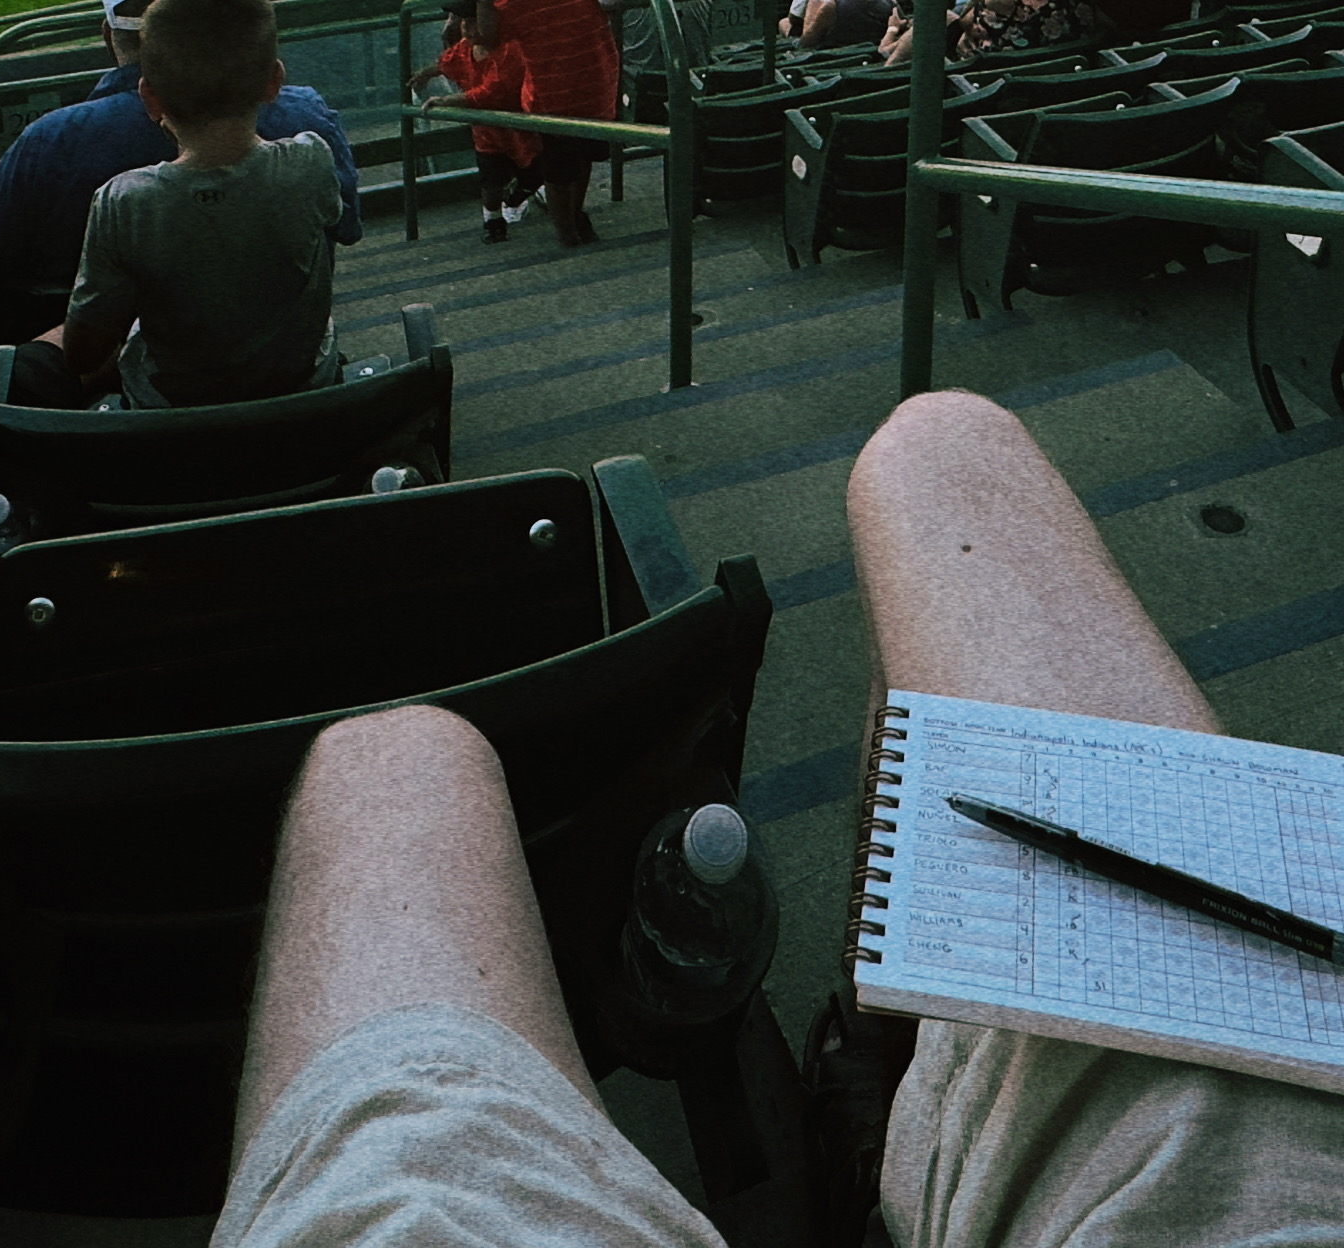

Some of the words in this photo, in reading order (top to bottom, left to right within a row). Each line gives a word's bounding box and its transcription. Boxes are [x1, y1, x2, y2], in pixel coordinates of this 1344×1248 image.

[717, 5, 751, 28] 203
[1011, 727, 1076, 746] Indianapolis
[927, 741, 966, 754] SIMON
[1022, 845, 1033, 856] 5
[914, 859, 968, 874] PEGUERO
[1022, 871, 1031, 881] 8
[1022, 897, 1030, 907] 2
[909, 910, 964, 928] WILLIAMS
[1202, 898, 1247, 921] FRIXION
[1250, 917, 1281, 936] BALL
[1020, 925, 1029, 936] 4
[908, 938, 953, 953] CHENG
[1019, 953, 1028, 964] 6
